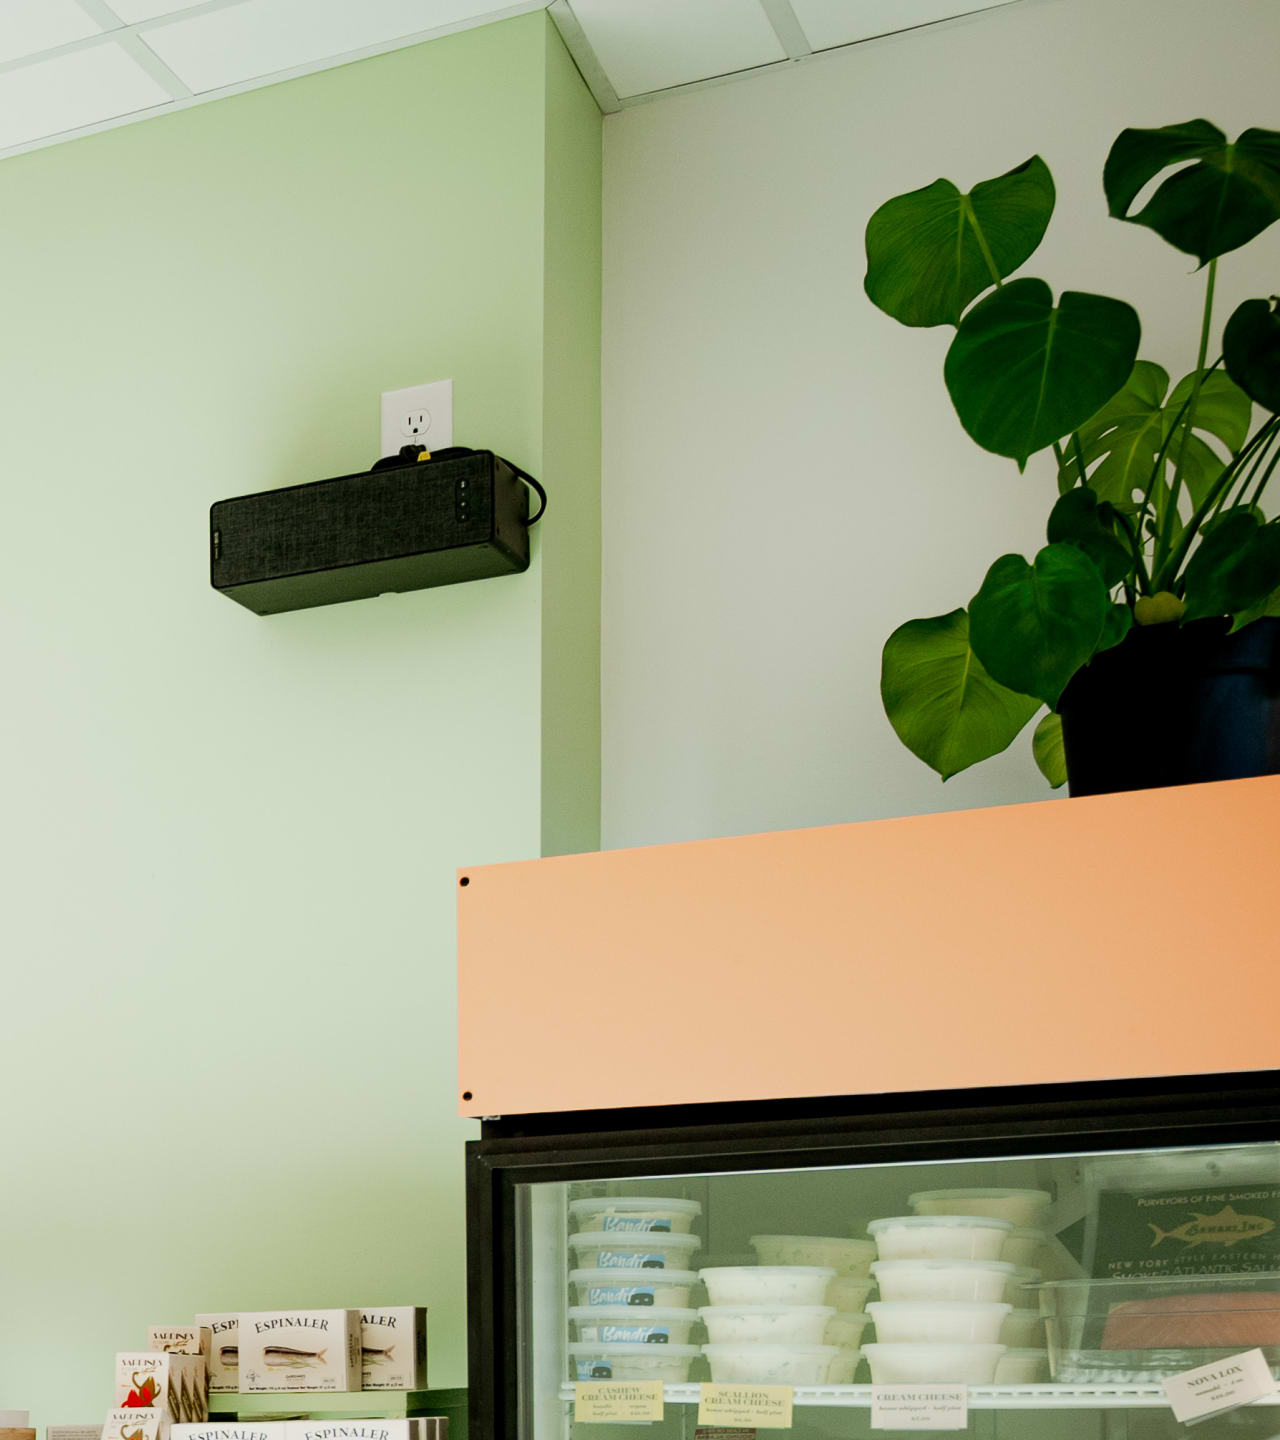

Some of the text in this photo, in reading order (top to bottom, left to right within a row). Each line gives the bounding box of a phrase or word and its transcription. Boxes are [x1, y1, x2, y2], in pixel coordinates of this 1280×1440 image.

[1139, 1258, 1169, 1268] YORK
[254, 1317, 330, 1335] ESPINALER
[1187, 1365, 1243, 1389] NOVA LOX
[875, 1392, 963, 1402] CREAM CHEESE
